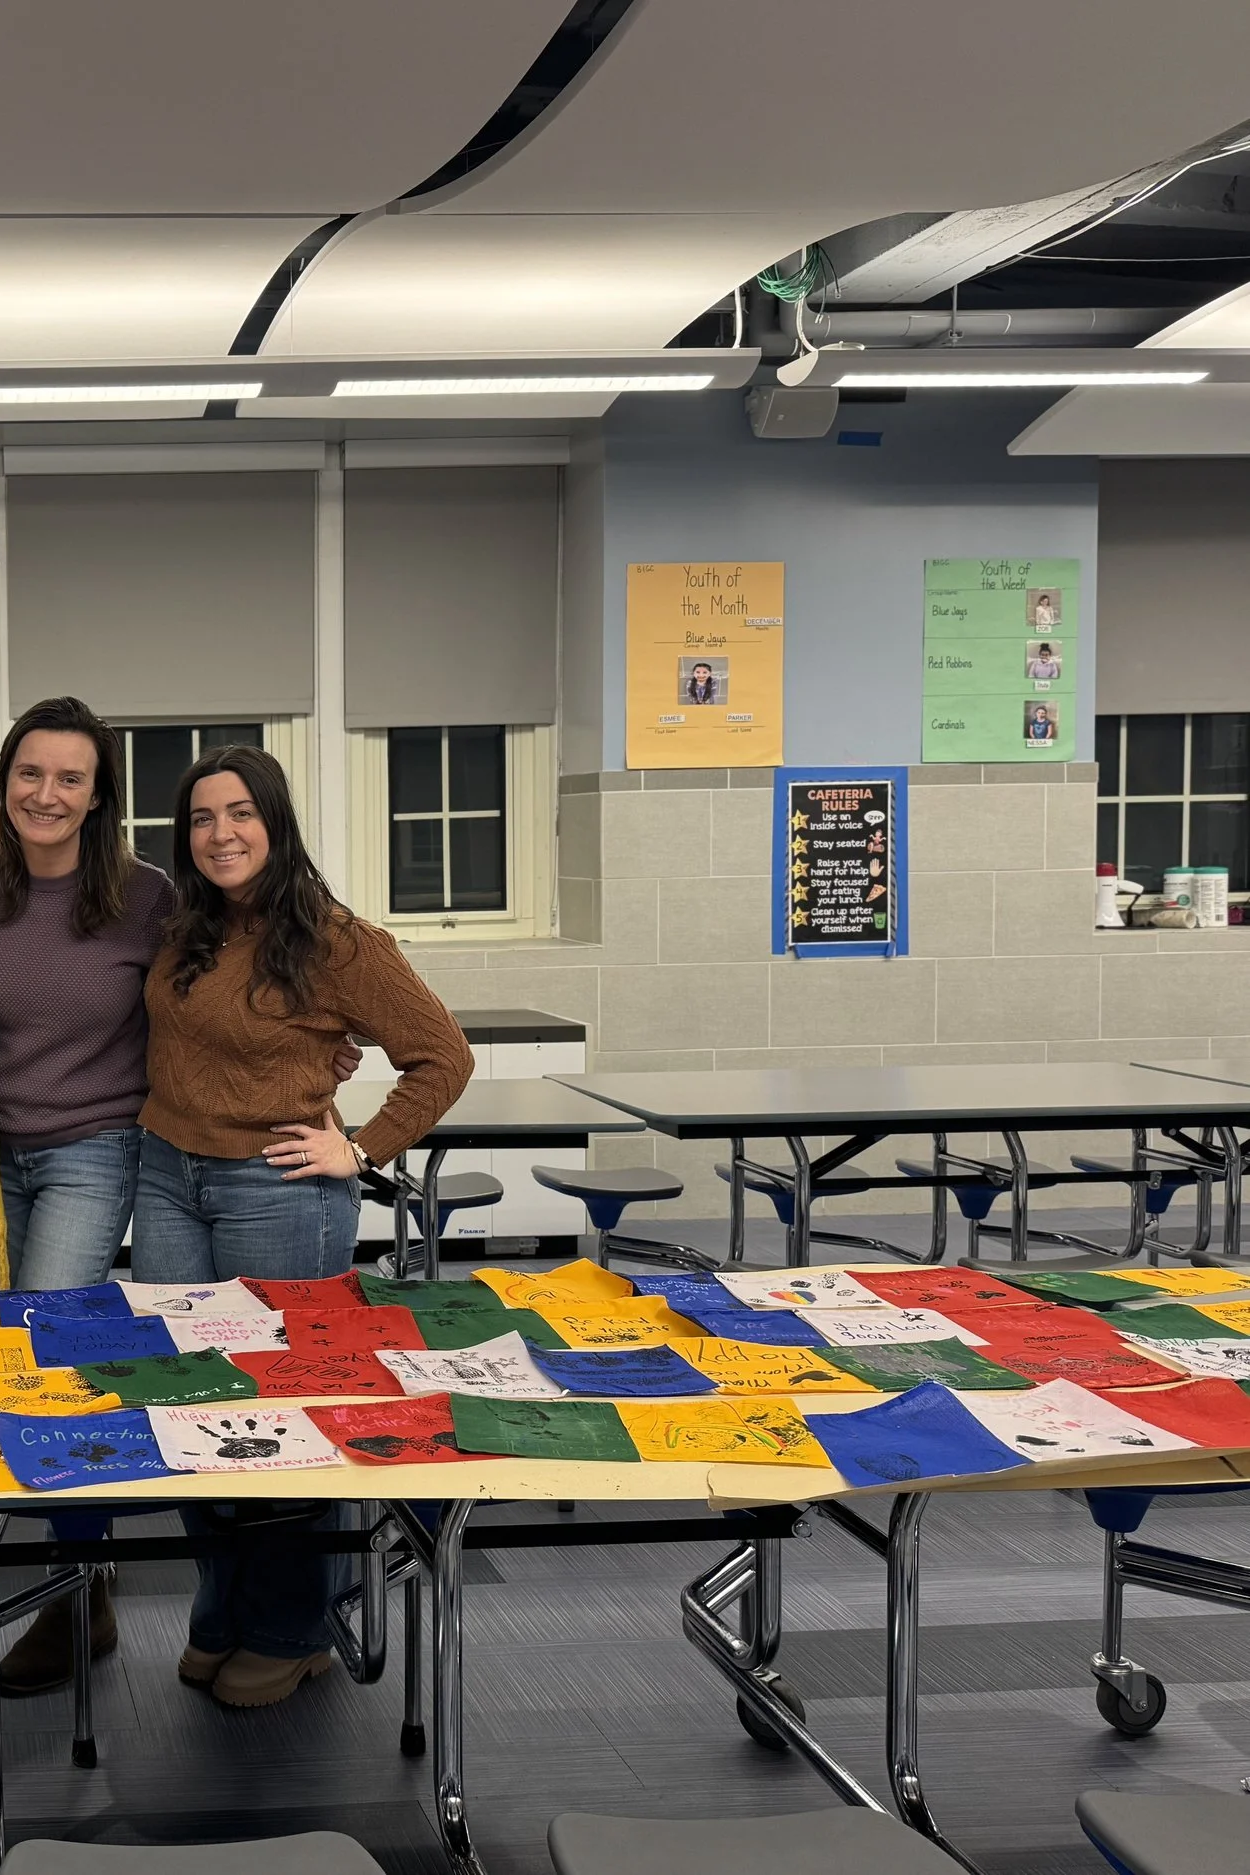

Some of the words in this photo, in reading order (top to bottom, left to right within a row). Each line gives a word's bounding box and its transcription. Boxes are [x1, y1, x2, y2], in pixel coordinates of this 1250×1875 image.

[980, 560, 1011, 576] Youth
[1018, 562, 1031, 575] of
[683, 565, 720, 588] Youth
[726, 567, 743, 588] of
[980, 578, 995, 590] the
[1001, 578, 1026, 590] Week
[681, 596, 700, 616] the
[710, 594, 748, 615] Month
[932, 604, 949, 616] Blue
[951, 606, 968, 620] Jays
[685, 631, 705, 643] Blue
[707, 633, 727, 647] Jays
[928, 656, 943, 669] Red
[931, 719, 965, 730] Cardinals
[807, 788, 873, 800] CAFETERIA
[822, 800, 859, 811] RULES
[822, 813, 837, 821] Use
[838, 822, 863, 830] voice
[796, 841, 803, 851] 2
[813, 840, 834, 850] Stay
[836, 839, 867, 848] seated
[797, 864, 802, 873] 3
[817, 859, 840, 867] Raise
[842, 859, 862, 868] your
[810, 868, 832, 876] hand
[835, 868, 848, 876] for
[850, 867, 869, 877] help
[811, 879, 831, 888] Stay
[834, 878, 869, 886] focused
[796, 889, 803, 897] 4
[832, 887, 861, 896] eating
[817, 897, 837, 906] your
[839, 896, 863, 904] lunch
[797, 913, 803, 923] 5
[811, 907, 834, 915] Clean
[837, 909, 847, 918] up
[811, 916, 846, 926] yourself
[849, 915, 873, 923] when
[821, 925, 862, 933] dismissed
[8, 1289, 89, 1307] SPREAD
[192, 1317, 244, 1330] make
[562, 1316, 594, 1327] Be
[733, 1322, 773, 1330] ARE
[191, 1327, 262, 1339] happen
[568, 1325, 587, 1333] to
[198, 1334, 252, 1343] today
[229, 1381, 245, 1389] I
[266, 1381, 306, 1390] you
[322, 1381, 344, 1389] be
[166, 1410, 212, 1423] HIGH
[237, 1412, 291, 1424] FIVE
[356, 1410, 392, 1421] be
[346, 1418, 414, 1434] nature
[21, 1427, 156, 1446] Connection
[82, 1461, 129, 1471] Trees
[177, 1462, 248, 1471] Including
[253, 1453, 342, 1470] EVERYONE!
